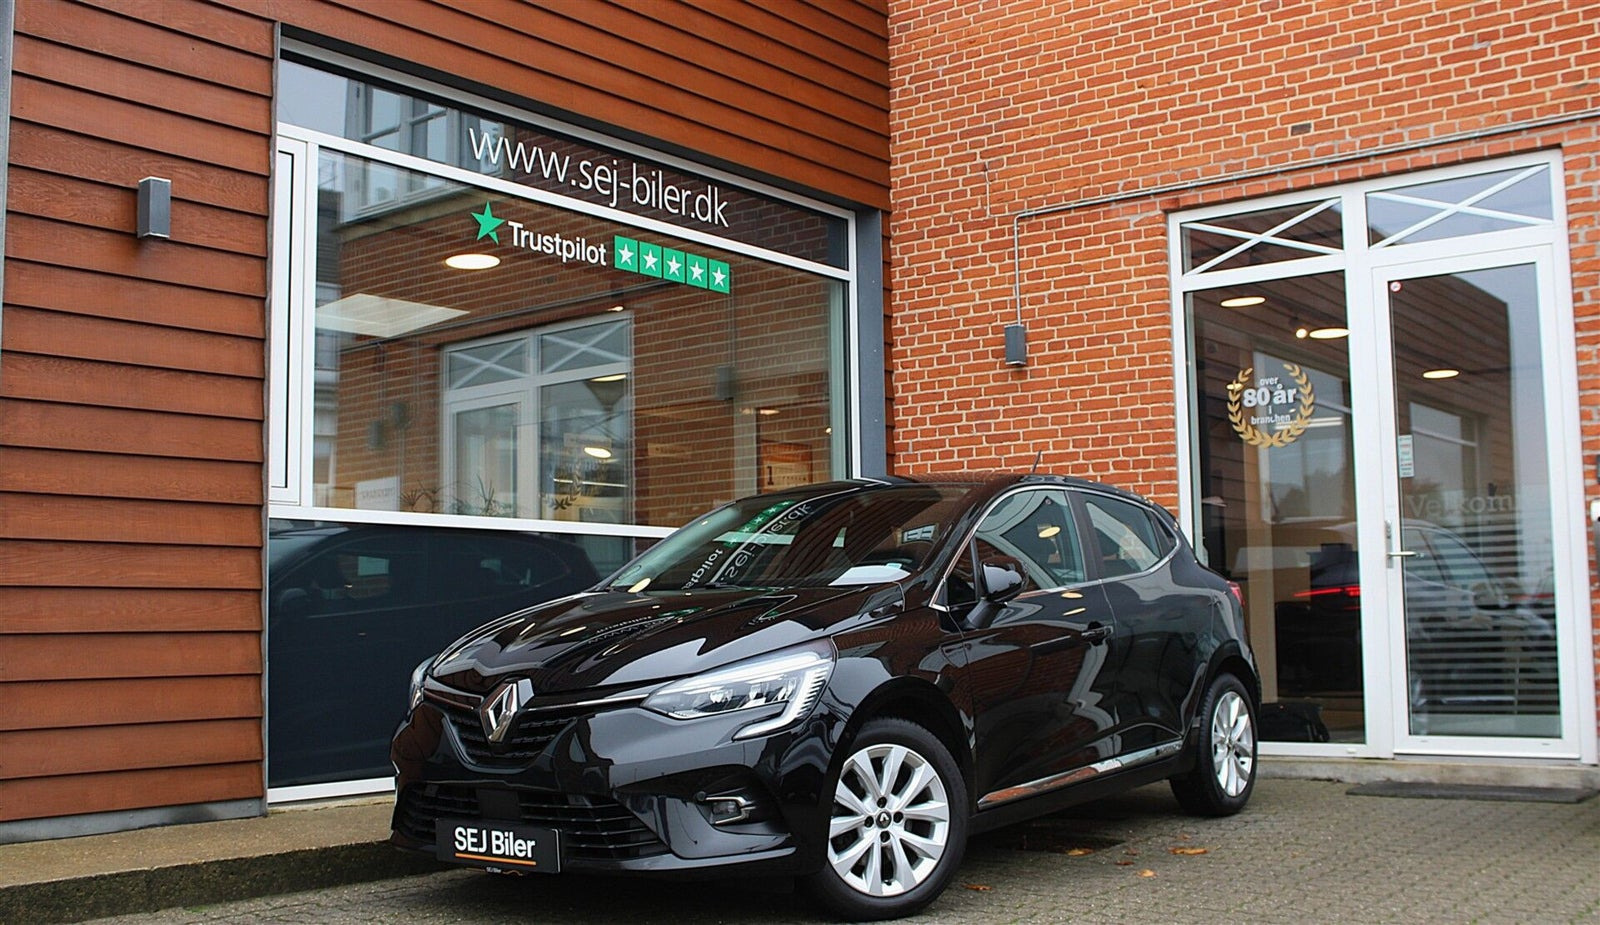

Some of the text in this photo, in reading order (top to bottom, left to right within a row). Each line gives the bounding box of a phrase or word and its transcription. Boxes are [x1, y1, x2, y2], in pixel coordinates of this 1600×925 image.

[468, 127, 730, 228] www.sej-biler.dk
[507, 220, 607, 267] Trustpilot
[1243, 383, 1297, 408] 80 år
[1260, 376, 1279, 386] over
[454, 826, 536, 858] SEJ Biler
